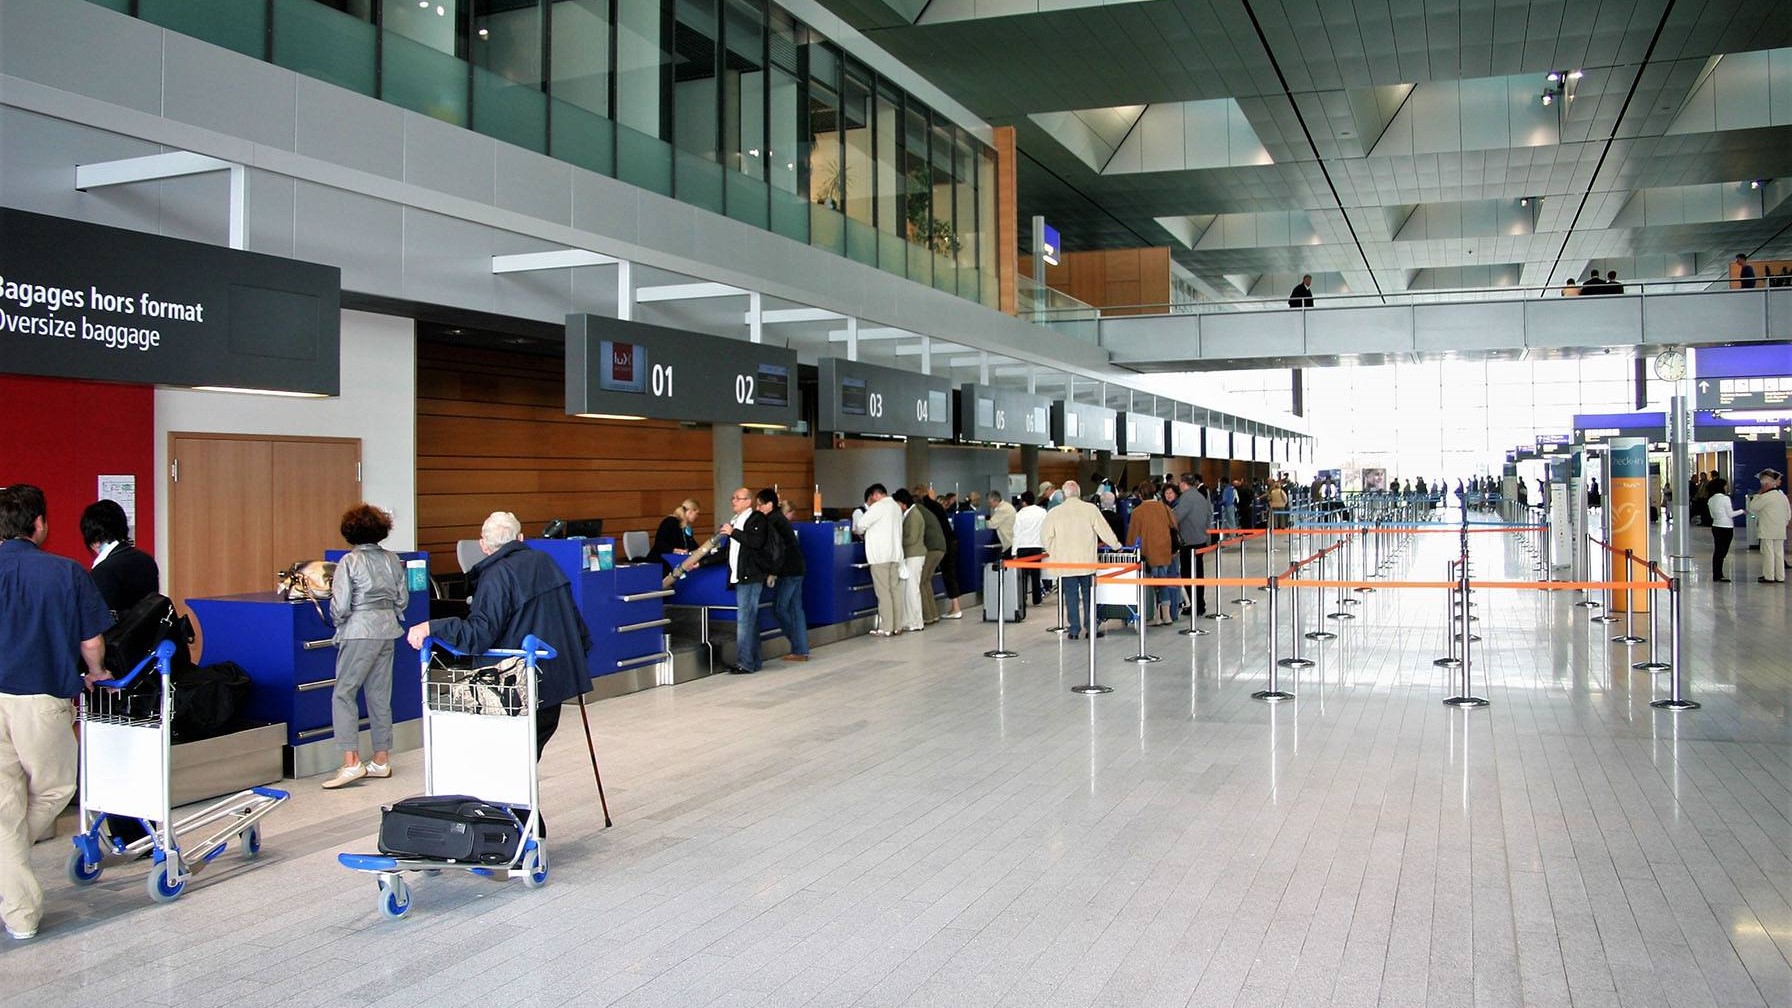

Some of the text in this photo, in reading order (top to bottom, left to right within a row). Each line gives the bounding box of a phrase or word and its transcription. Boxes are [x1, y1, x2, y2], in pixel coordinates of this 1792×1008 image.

[91, 286, 135, 314] hors
[140, 292, 204, 323] format
[82, 315, 160, 351] baggage
[652, 363, 673, 397] 01
[735, 374, 755, 405] 02
[870, 393, 883, 417] 03
[916, 399, 928, 422] 04
